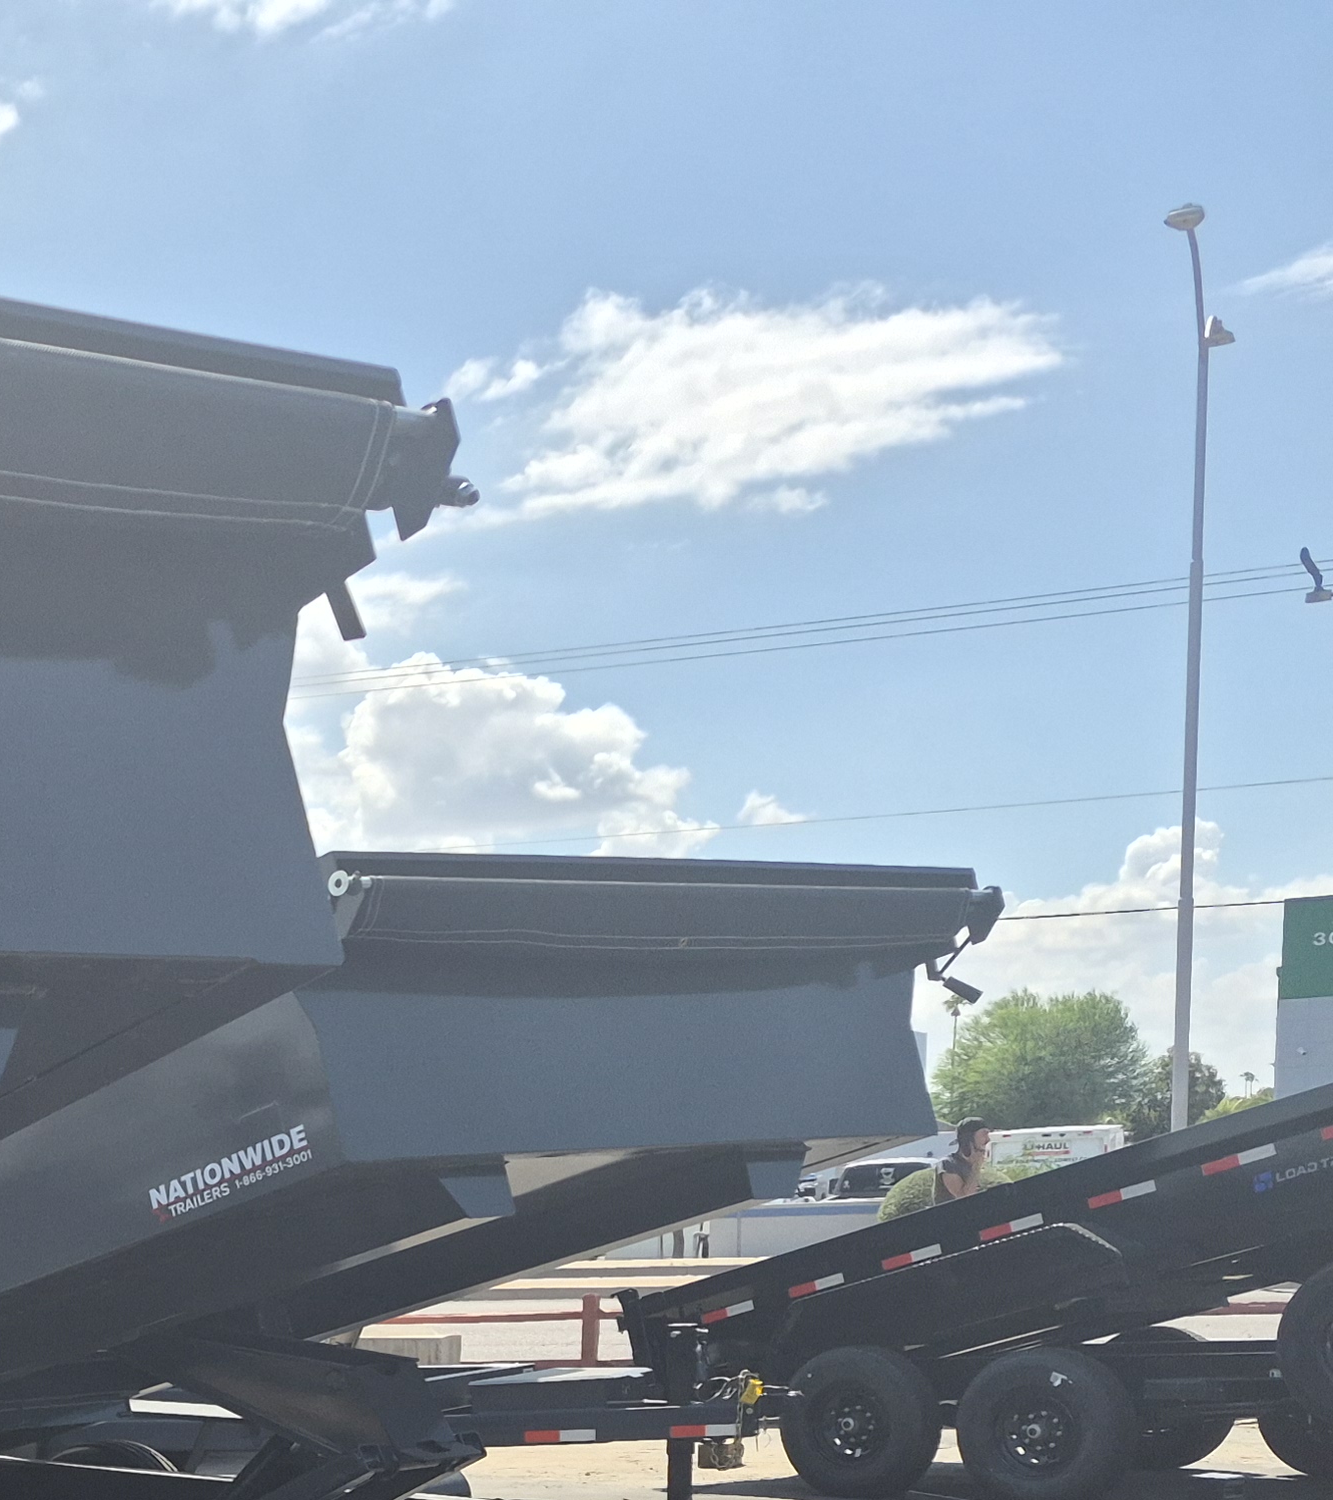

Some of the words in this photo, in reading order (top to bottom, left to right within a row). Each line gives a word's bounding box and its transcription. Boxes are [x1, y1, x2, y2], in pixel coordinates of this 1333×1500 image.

[148, 1124, 308, 1209] NATIONWIDE
[168, 1183, 230, 1217] TRAILERS
[234, 1149, 313, 1190] 1-866-931-3001
[1276, 1162, 1318, 1182] LOAD
